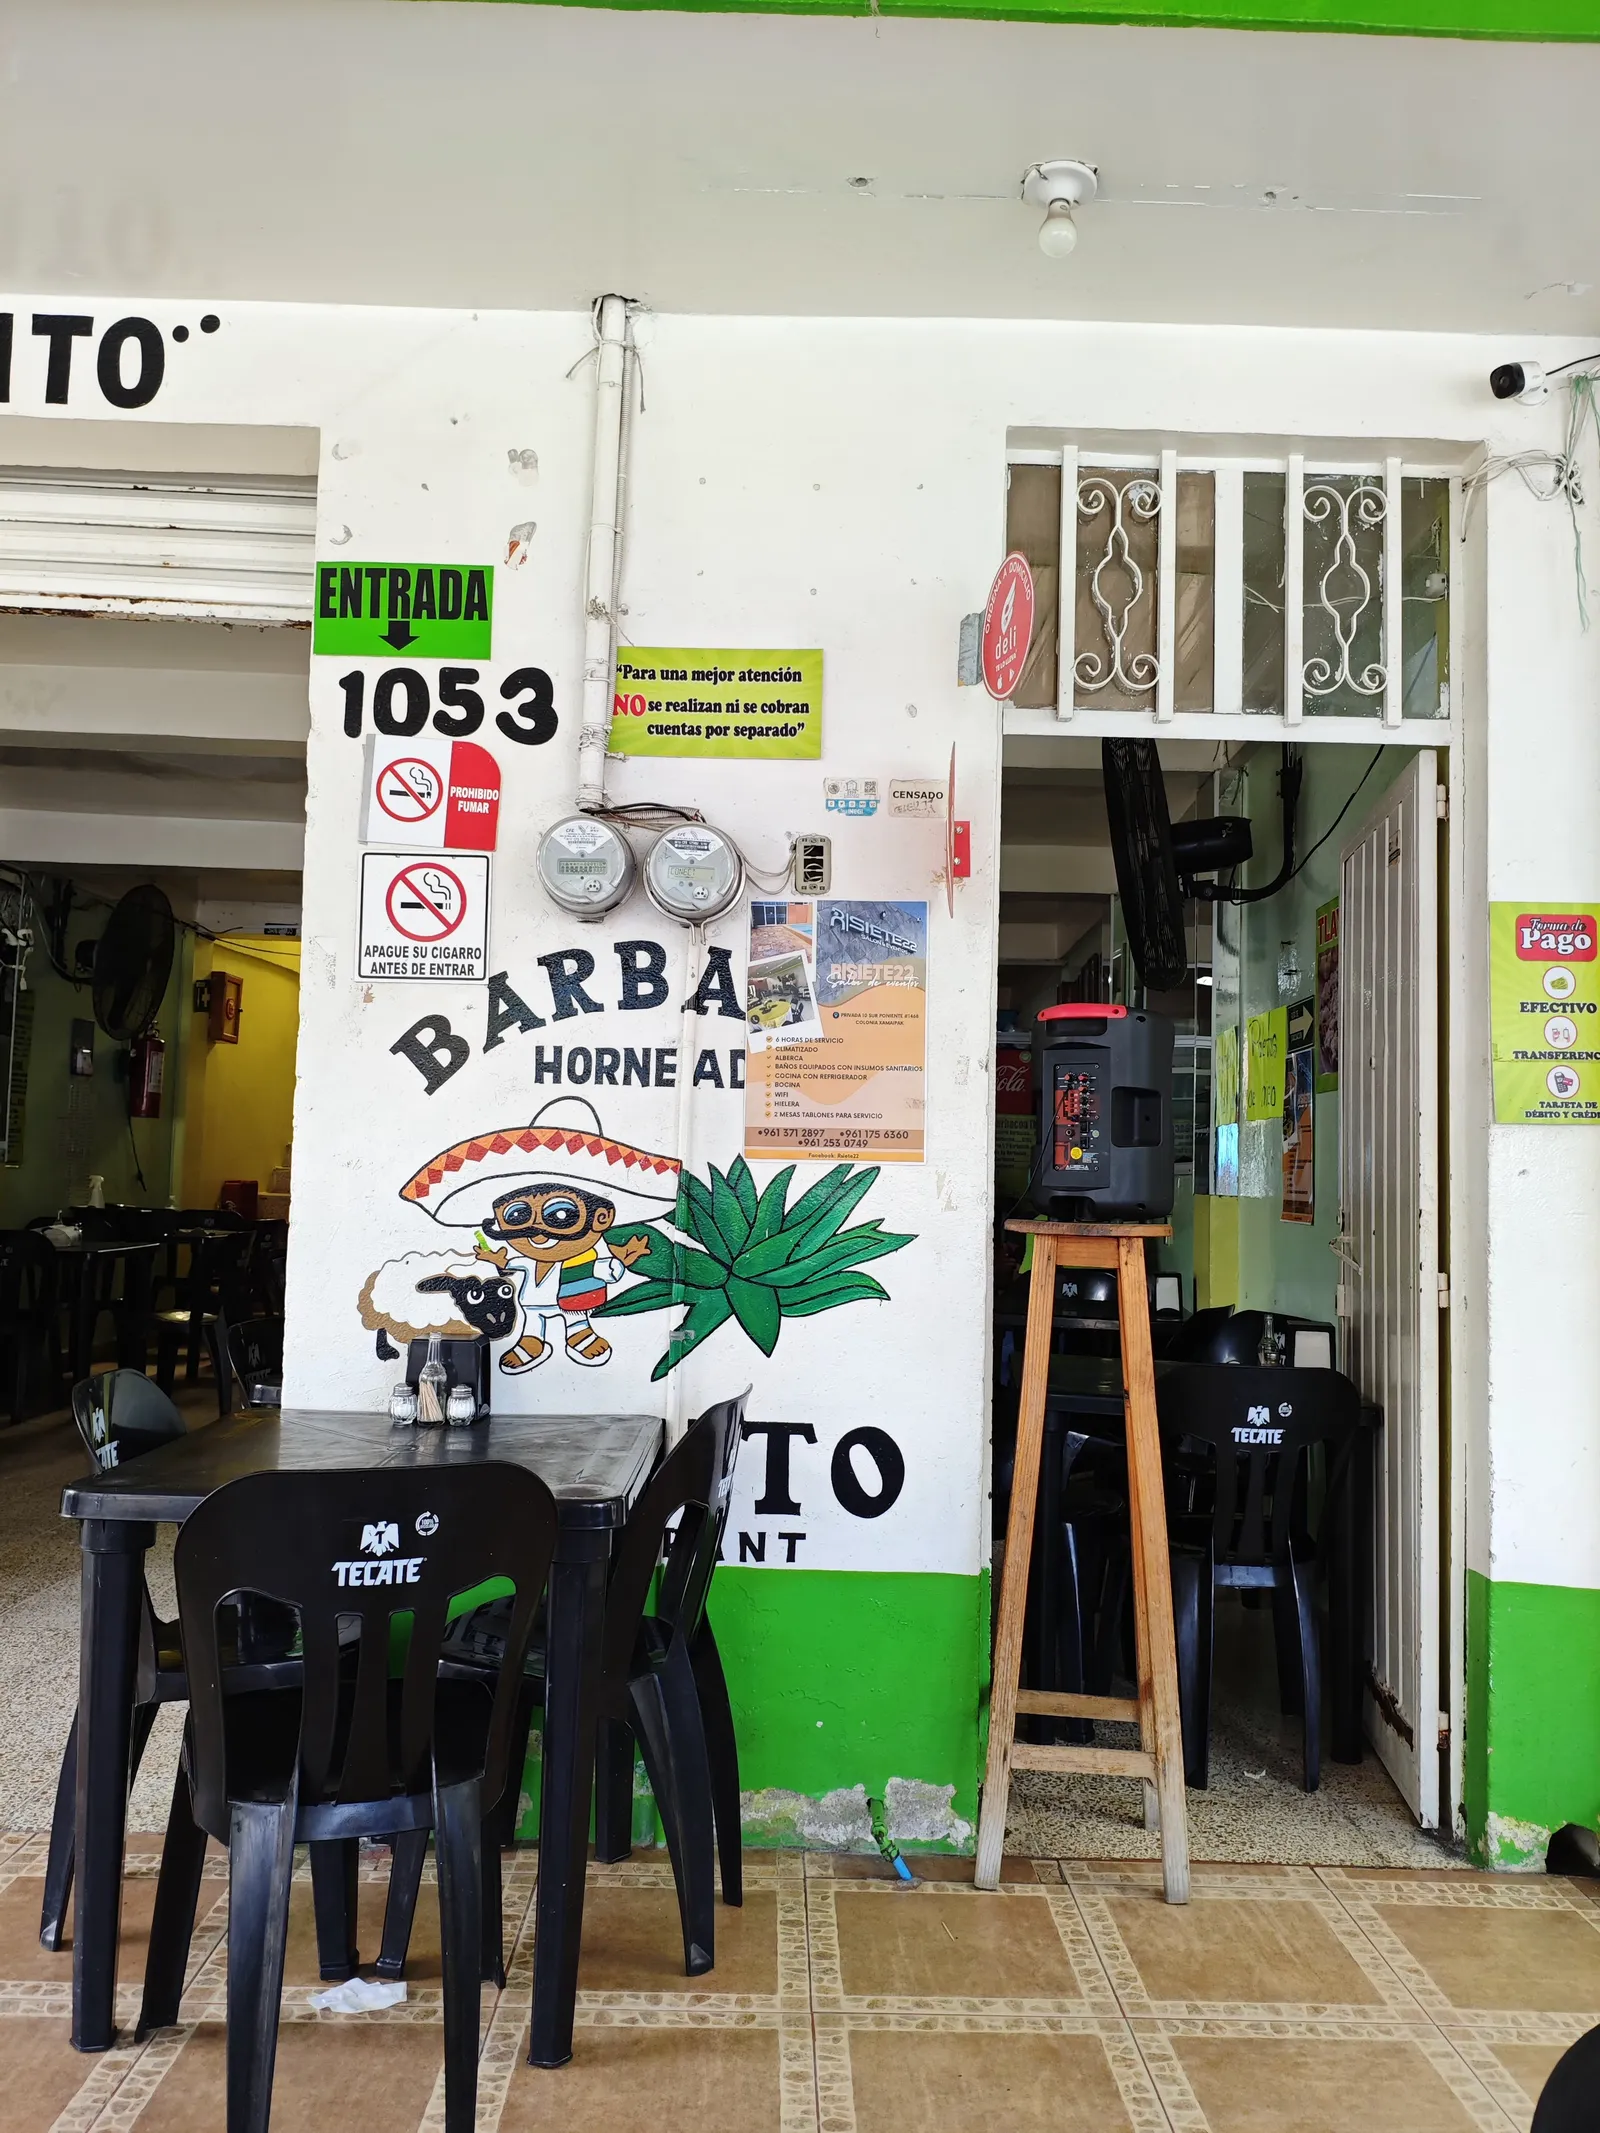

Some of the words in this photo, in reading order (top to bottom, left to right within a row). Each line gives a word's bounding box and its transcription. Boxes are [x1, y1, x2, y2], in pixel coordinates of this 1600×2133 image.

[319, 568, 490, 622] ENTRADA
[985, 580, 1002, 634] ORDENA
[1009, 561, 1031, 601] DOMICILIO
[995, 625, 1017, 660] deli
[660, 669, 687, 681] una
[691, 667, 735, 685] mejor
[738, 667, 802, 682] atención
[339, 666, 559, 746] 1053
[613, 693, 646, 717] NO
[647, 701, 662, 712] se
[665, 698, 722, 713] realizan
[725, 699, 740, 713] ni
[743, 702, 757, 713] se
[760, 699, 809, 714] cobran
[647, 722, 702, 736] cuentas
[705, 724, 730, 739] por
[450, 785, 499, 801] PROHIBIDO
[892, 790, 944, 800] CENSADO
[457, 800, 490, 815] FUMAR
[1529, 917, 1569, 931] Forma
[1570, 918, 1586, 932] de
[1520, 926, 1593, 956] Pago
[364, 945, 409, 960] APAGUE
[412, 945, 428, 959] SU
[431, 946, 482, 960] CIGARRO
[370, 961, 410, 976] ANTES
[411, 962, 427, 976] DE
[429, 963, 475, 977] ENTRAR
[830, 962, 915, 981] RISIETE22
[1519, 1002, 1598, 1014] EFECTIVO
[1513, 1050, 1600, 1060] TRANSFERENC
[775, 1062, 798, 1070] BAÑOS
[1539, 1101, 1583, 1109] TARJETA
[1585, 1101, 1598, 1109] DE
[1525, 1109, 1561, 1118] DÉBITO
[763, 1128, 780, 1137] 961
[783, 1129, 798, 1137] 371
[801, 1129, 825, 1138] 2897
[845, 1129, 862, 1138] 961
[865, 1130, 881, 1139] 175
[883, 1130, 909, 1139] 6360
[803, 1138, 820, 1147] 961
[823, 1139, 841, 1147] 253
[843, 1139, 869, 1148] 0749
[1231, 1427, 1284, 1445] TECATE
[688, 1418, 905, 1519] TO
[331, 1557, 424, 1587] TECATE
